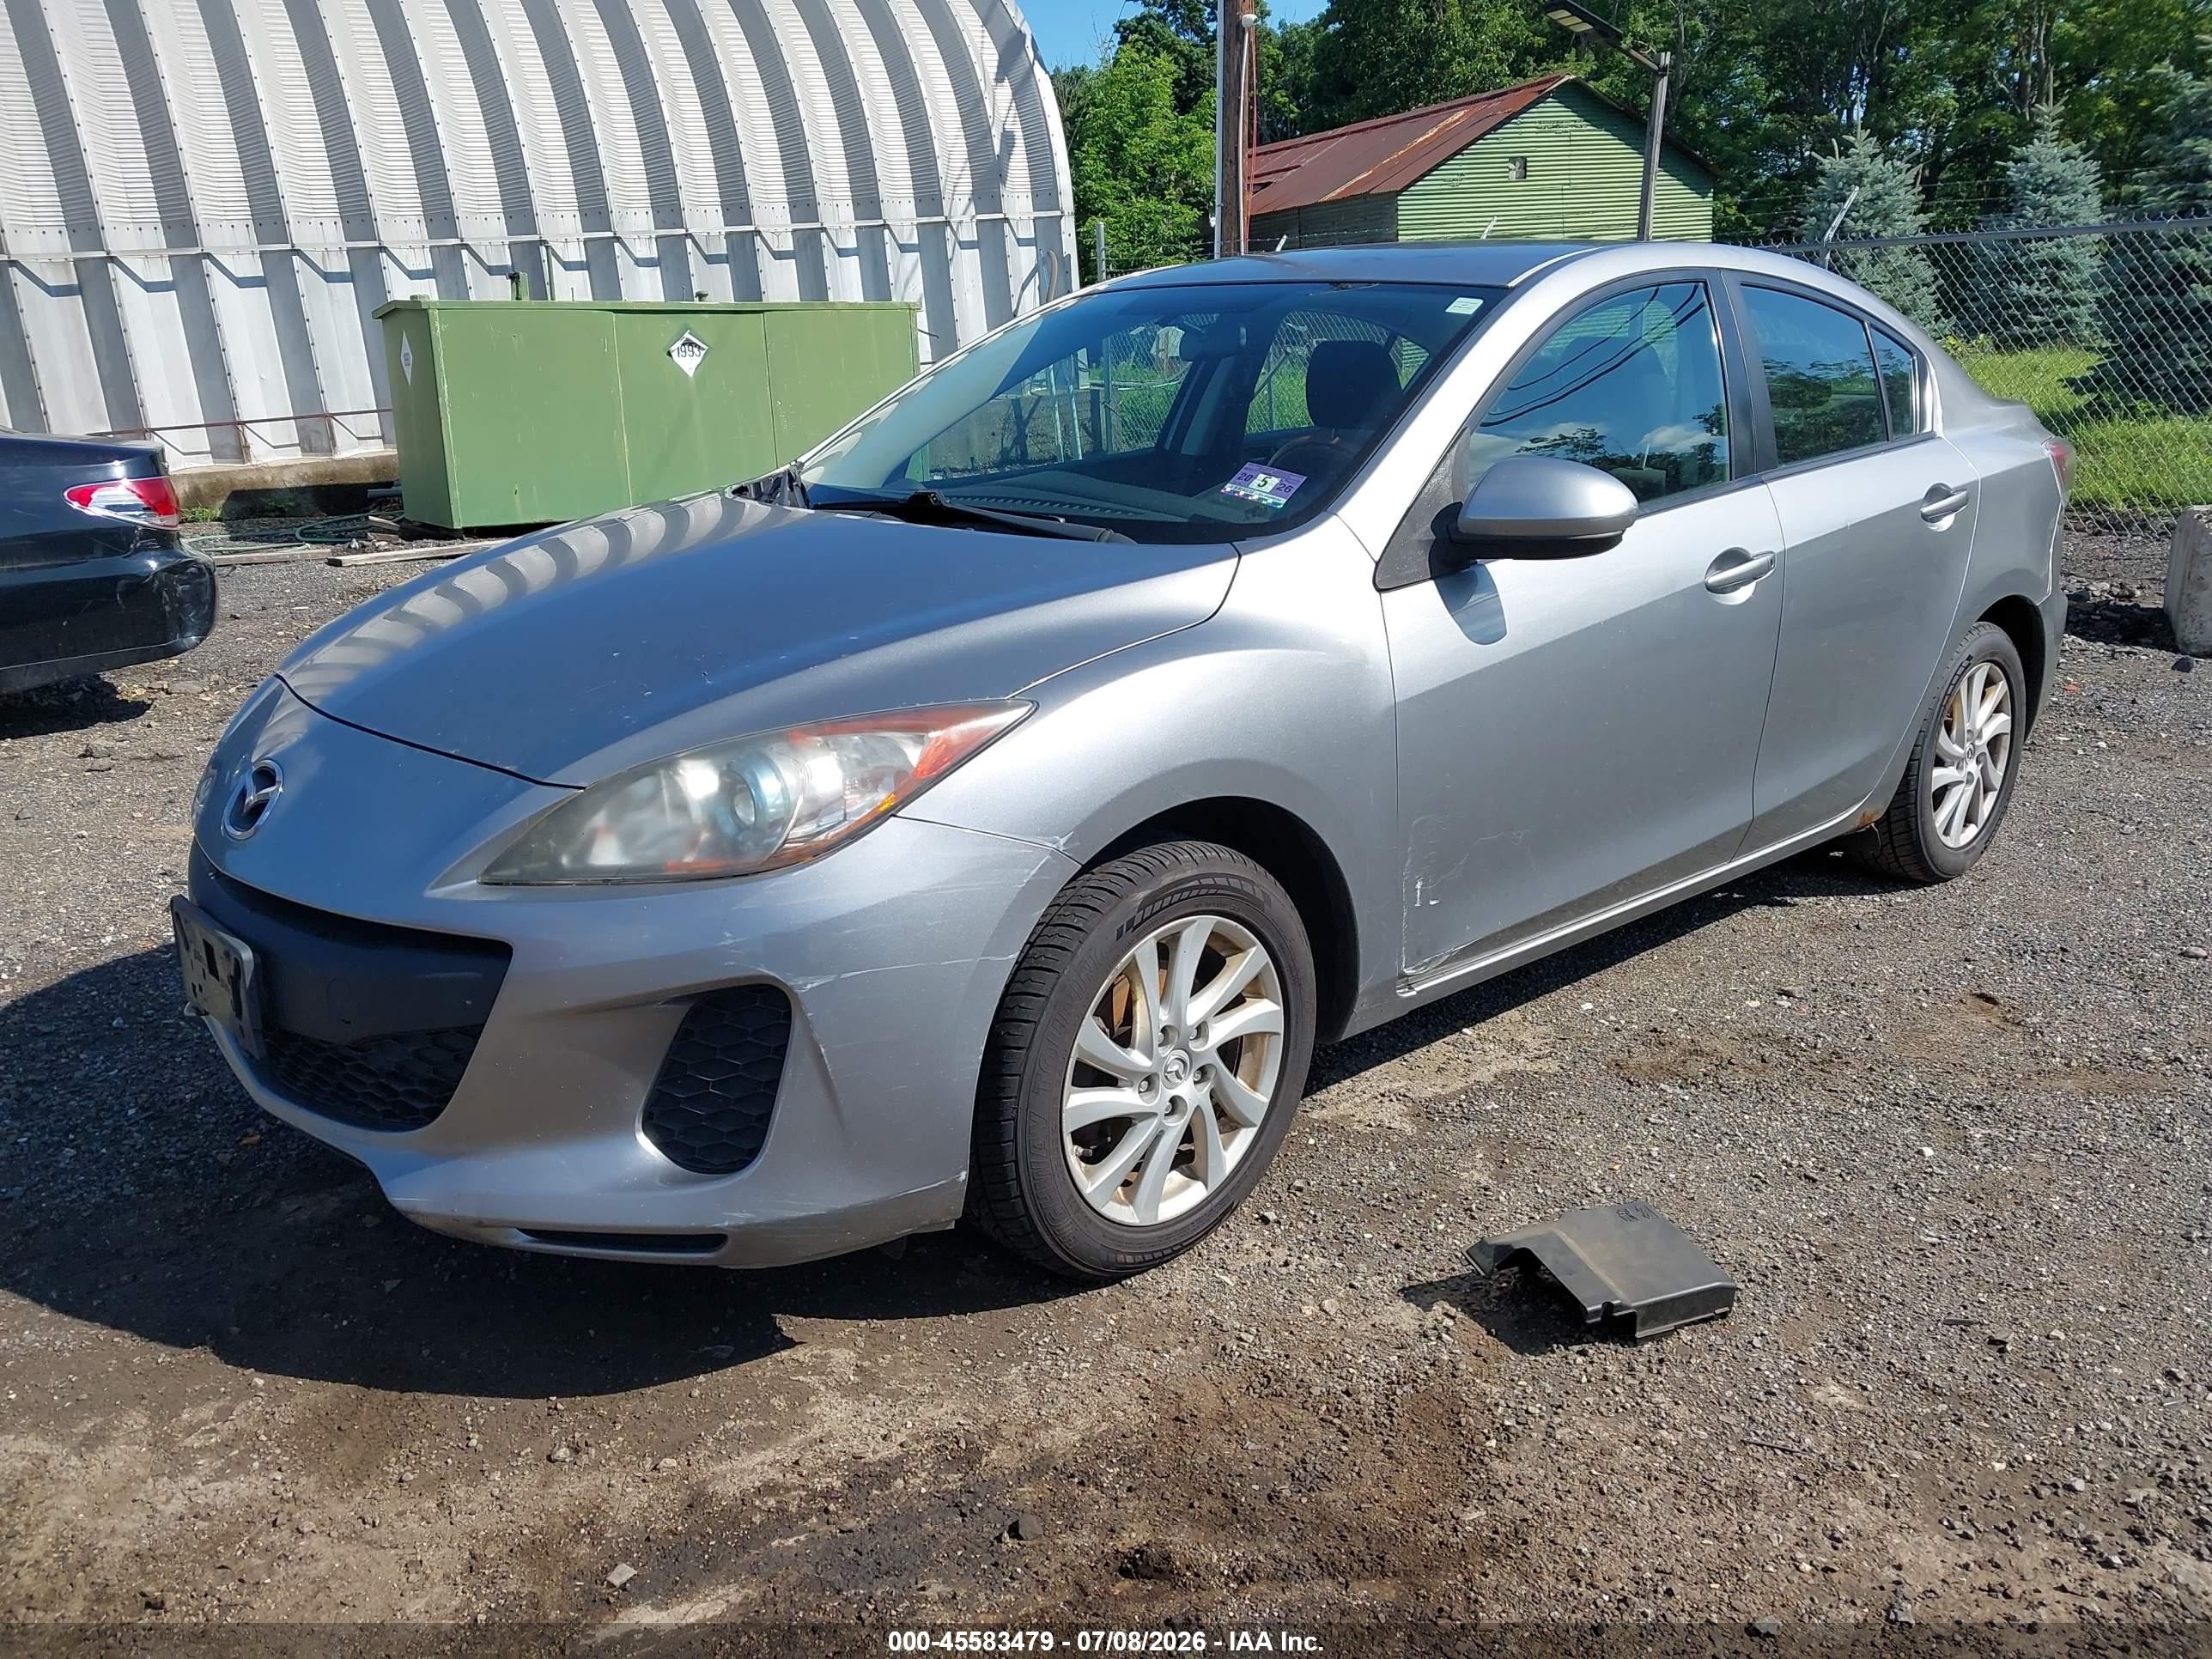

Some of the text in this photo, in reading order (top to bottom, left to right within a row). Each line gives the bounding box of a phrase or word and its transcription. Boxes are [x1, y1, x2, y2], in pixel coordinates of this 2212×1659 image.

[676, 343, 702, 358] 1993
[1237, 472, 1254, 483] 20
[1257, 476, 1273, 488] 5
[1276, 483, 1294, 494] 26
